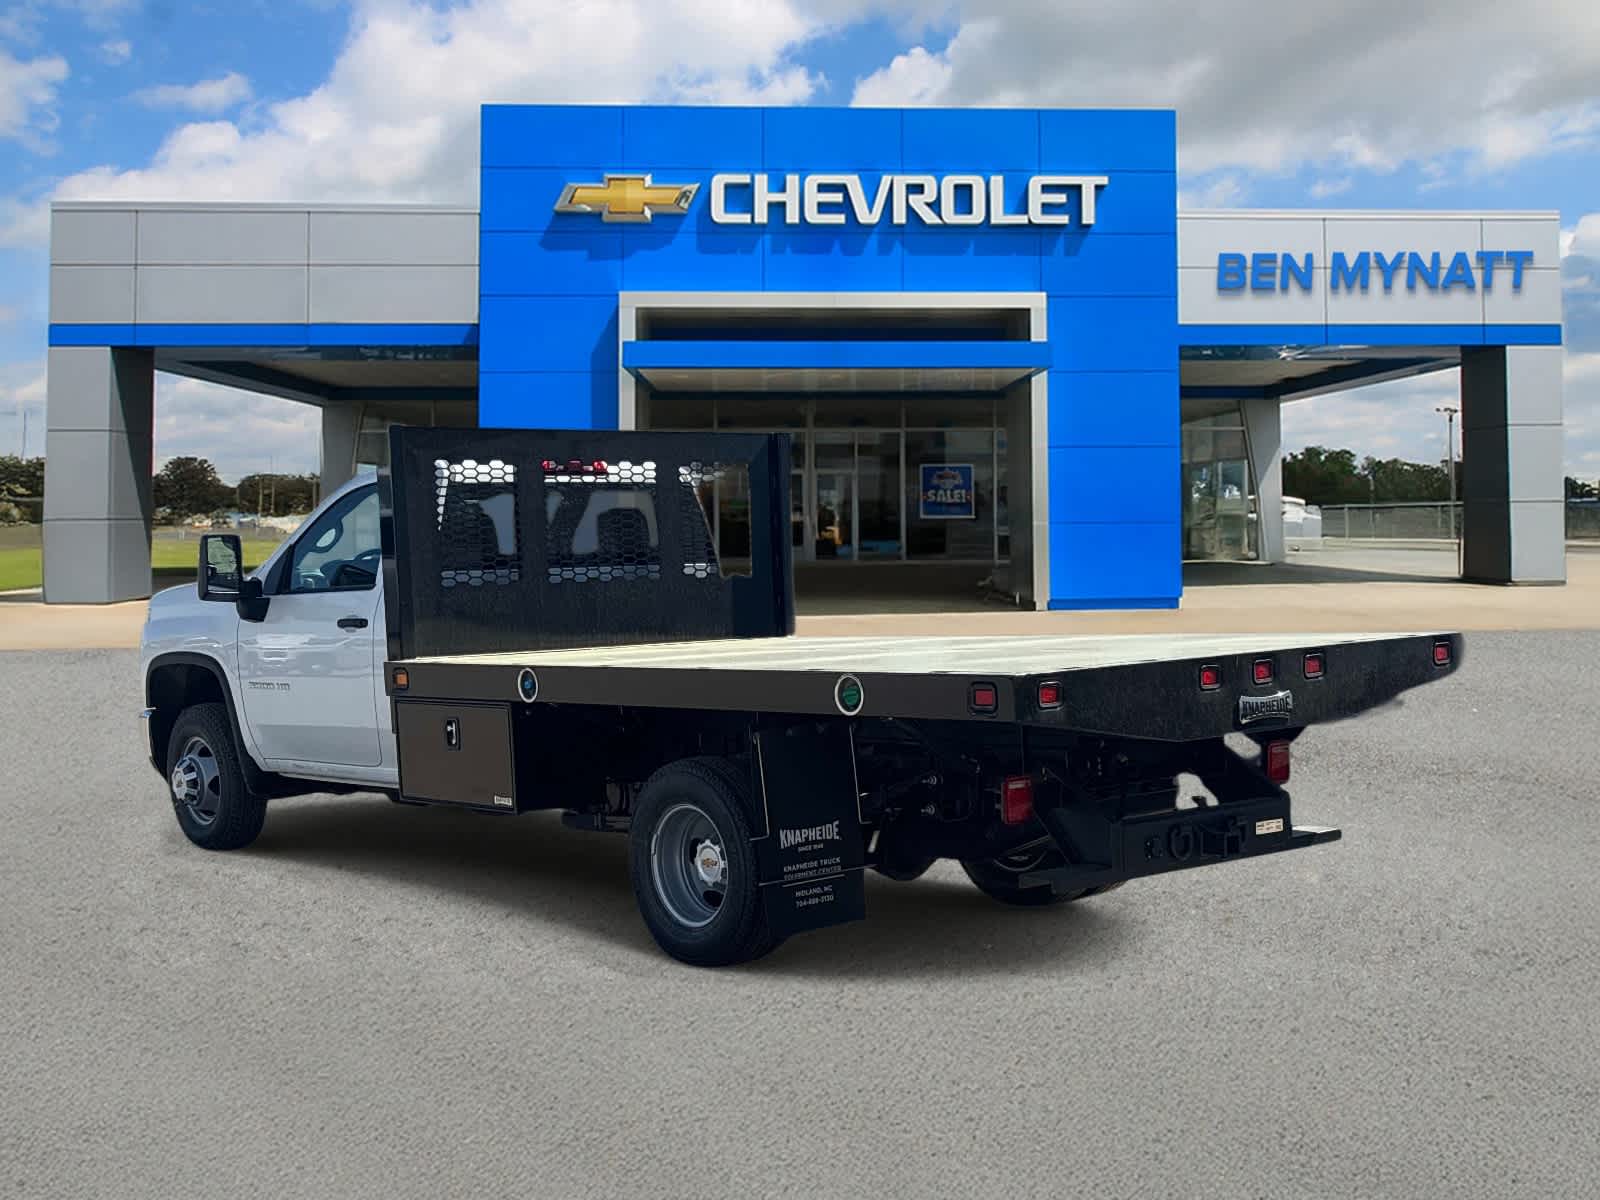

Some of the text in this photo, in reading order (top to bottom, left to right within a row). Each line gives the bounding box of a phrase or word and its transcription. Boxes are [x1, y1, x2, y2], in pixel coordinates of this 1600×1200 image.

[711, 173, 1109, 225] CHEVROLET
[1217, 250, 1534, 291] BEN MYNATT
[927, 489, 966, 503] SALE!
[1241, 694, 1293, 718] KNAPHEIDE
[780, 820, 840, 849] KNAPHEIDE
[784, 857, 840, 872] KNAPHEIDE TRUCK
